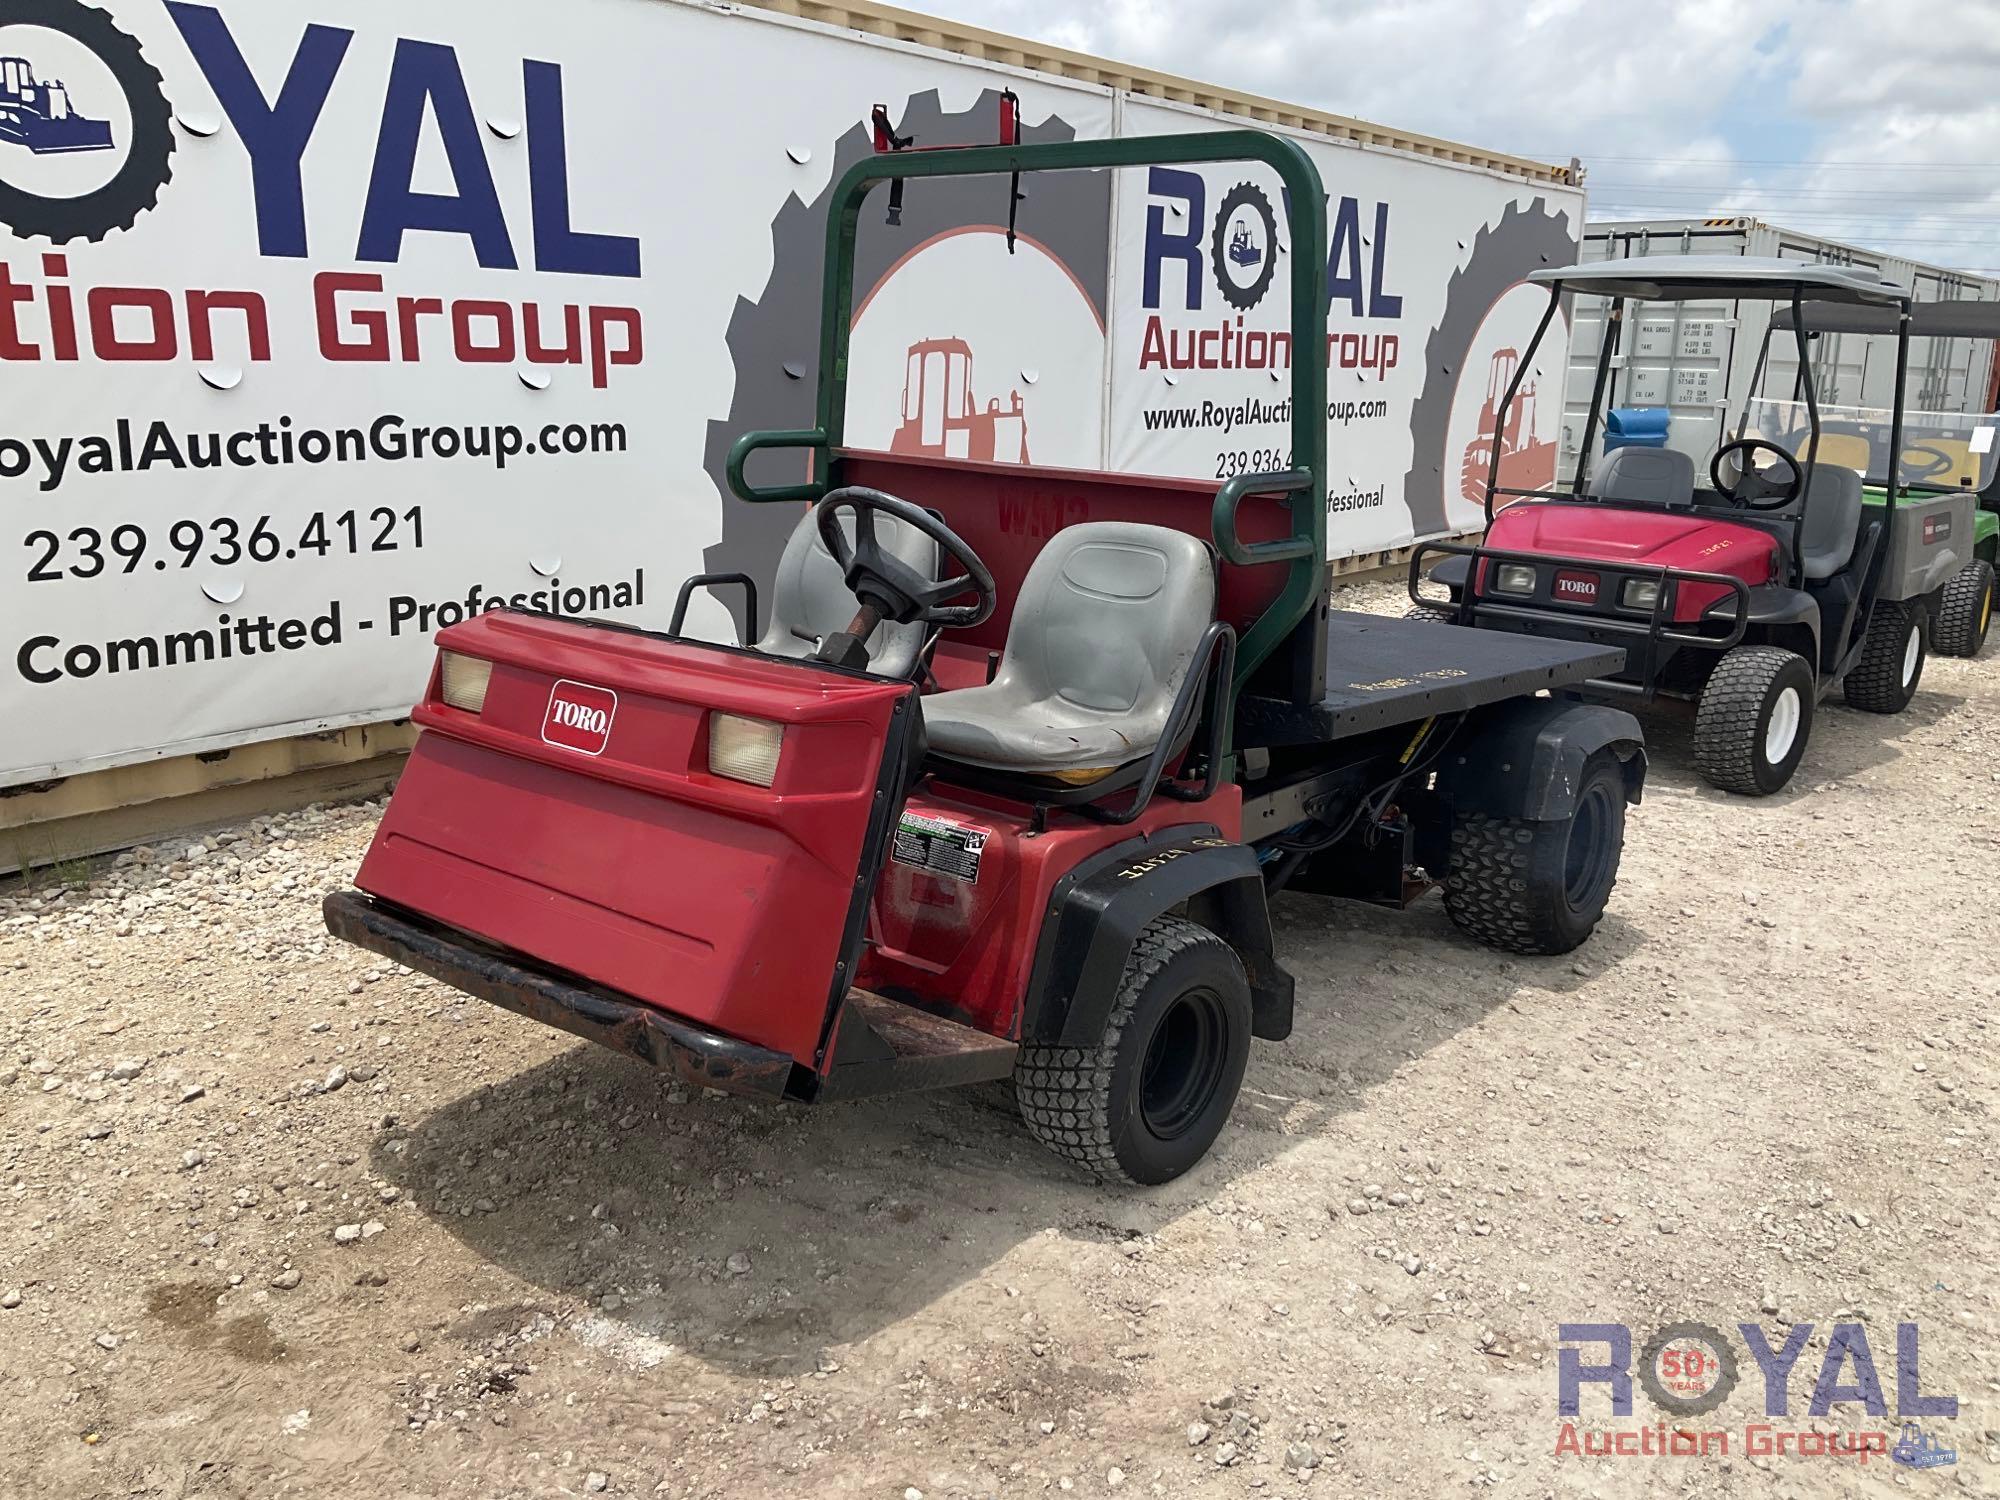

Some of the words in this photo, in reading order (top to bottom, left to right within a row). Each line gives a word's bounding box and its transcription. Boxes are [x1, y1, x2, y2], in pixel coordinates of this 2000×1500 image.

[313, 270, 642, 389] Group
[1139, 315, 1291, 370] Auction
[1326, 333, 1399, 381] roup
[24, 505, 425, 582] 239.936.4121
[1559, 579, 1595, 594] TORO
[16, 602, 342, 684] Committed
[552, 699, 606, 734] TORO
